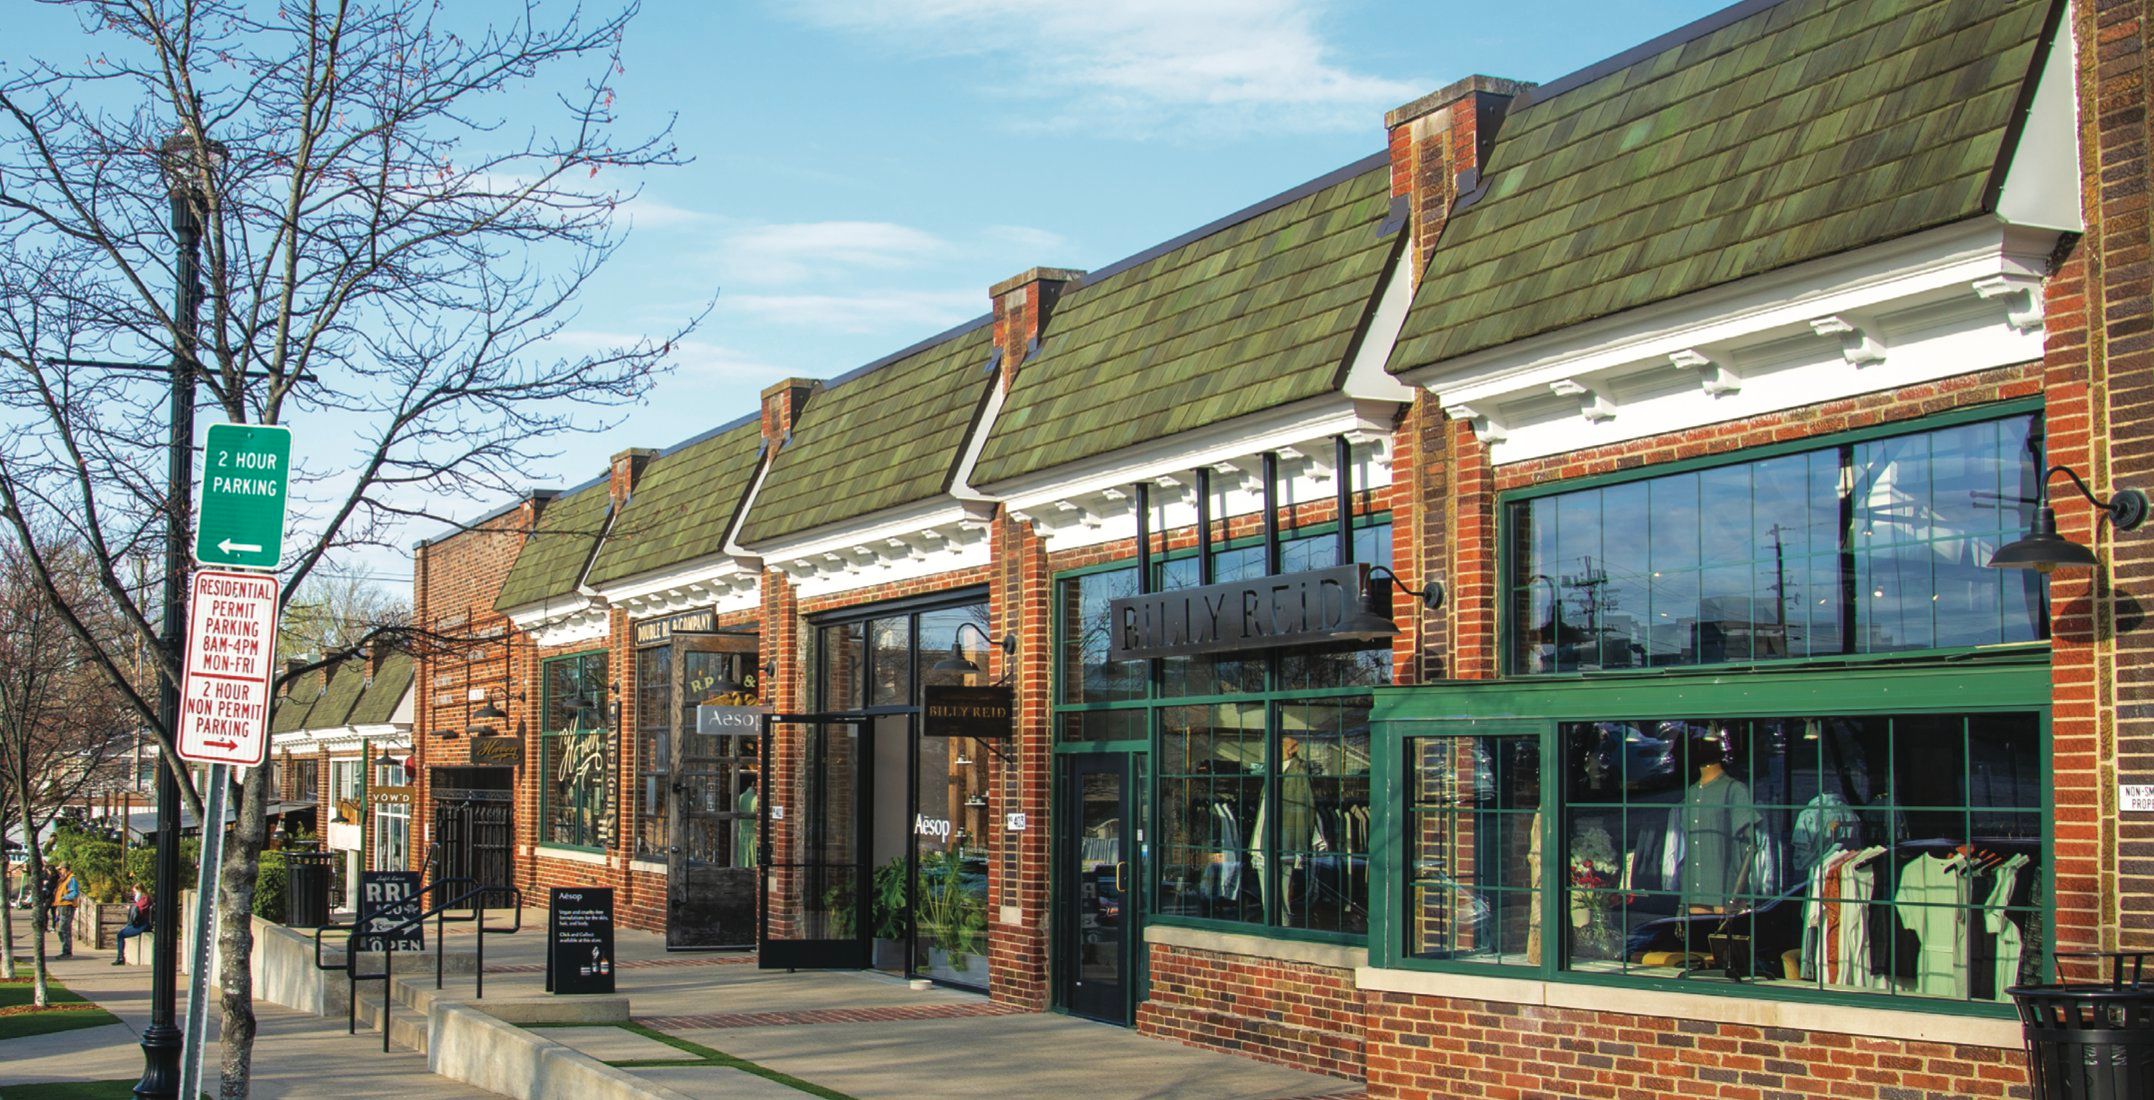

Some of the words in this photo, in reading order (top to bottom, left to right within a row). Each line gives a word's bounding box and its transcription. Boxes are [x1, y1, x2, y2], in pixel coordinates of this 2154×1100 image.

[218, 451, 228, 467] 2
[236, 452, 277, 470] HOUR
[213, 477, 277, 497] PARKING
[200, 578, 272, 600] RESIDENTIAL
[212, 600, 256, 619] PERMIT
[205, 618, 259, 637] PARKING
[638, 622, 661, 642] DOUBLE
[678, 613, 711, 631] COMPANY
[203, 635, 259, 655] 8AM-4PM
[203, 654, 255, 674] MON-FRI
[203, 681, 209, 697] 2
[216, 682, 250, 700] HOUR
[187, 698, 215, 715] NON
[218, 702, 262, 720] PERMIT
[929, 705, 968, 718] BILLY
[972, 706, 1007, 719] REID
[196, 718, 250, 738] PARKING
[373, 793, 410, 802] VOW'D
